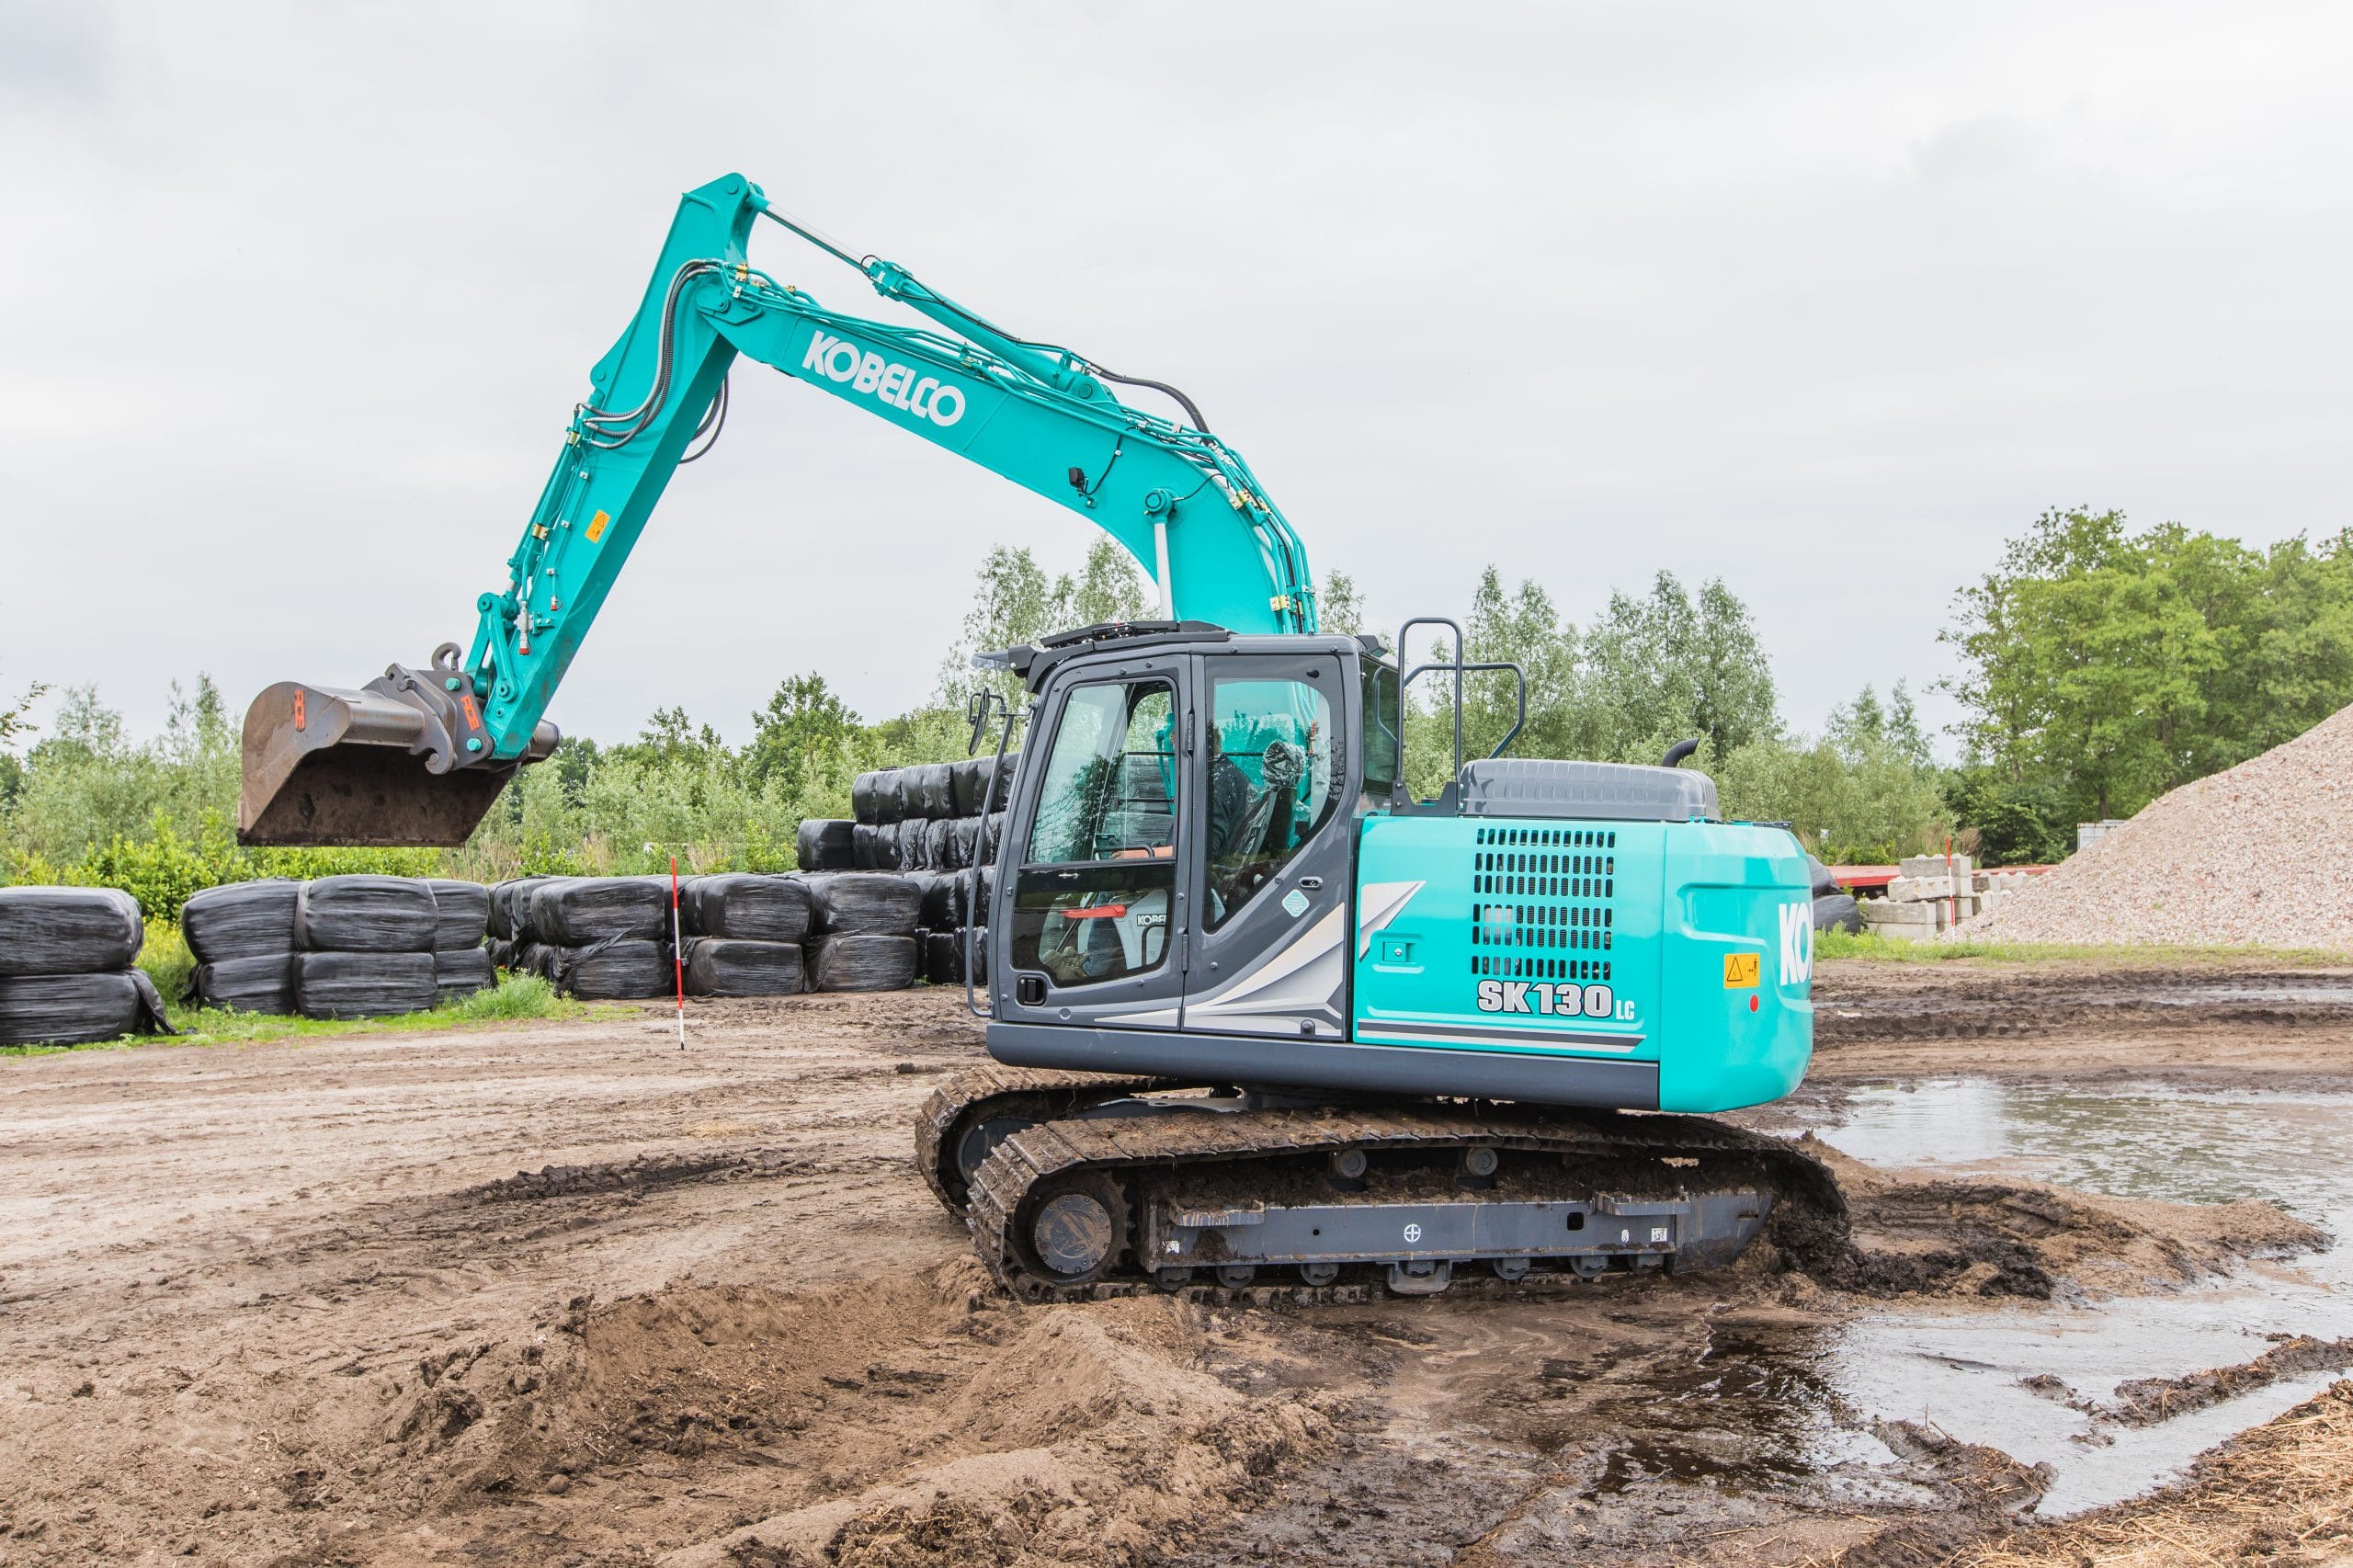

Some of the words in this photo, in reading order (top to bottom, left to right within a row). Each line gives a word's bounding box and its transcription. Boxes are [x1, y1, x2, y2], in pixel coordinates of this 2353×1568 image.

[801, 329, 966, 427] KOBELCO
[1477, 979, 1614, 1019] SK130
[1616, 1000, 1635, 1021] LC
